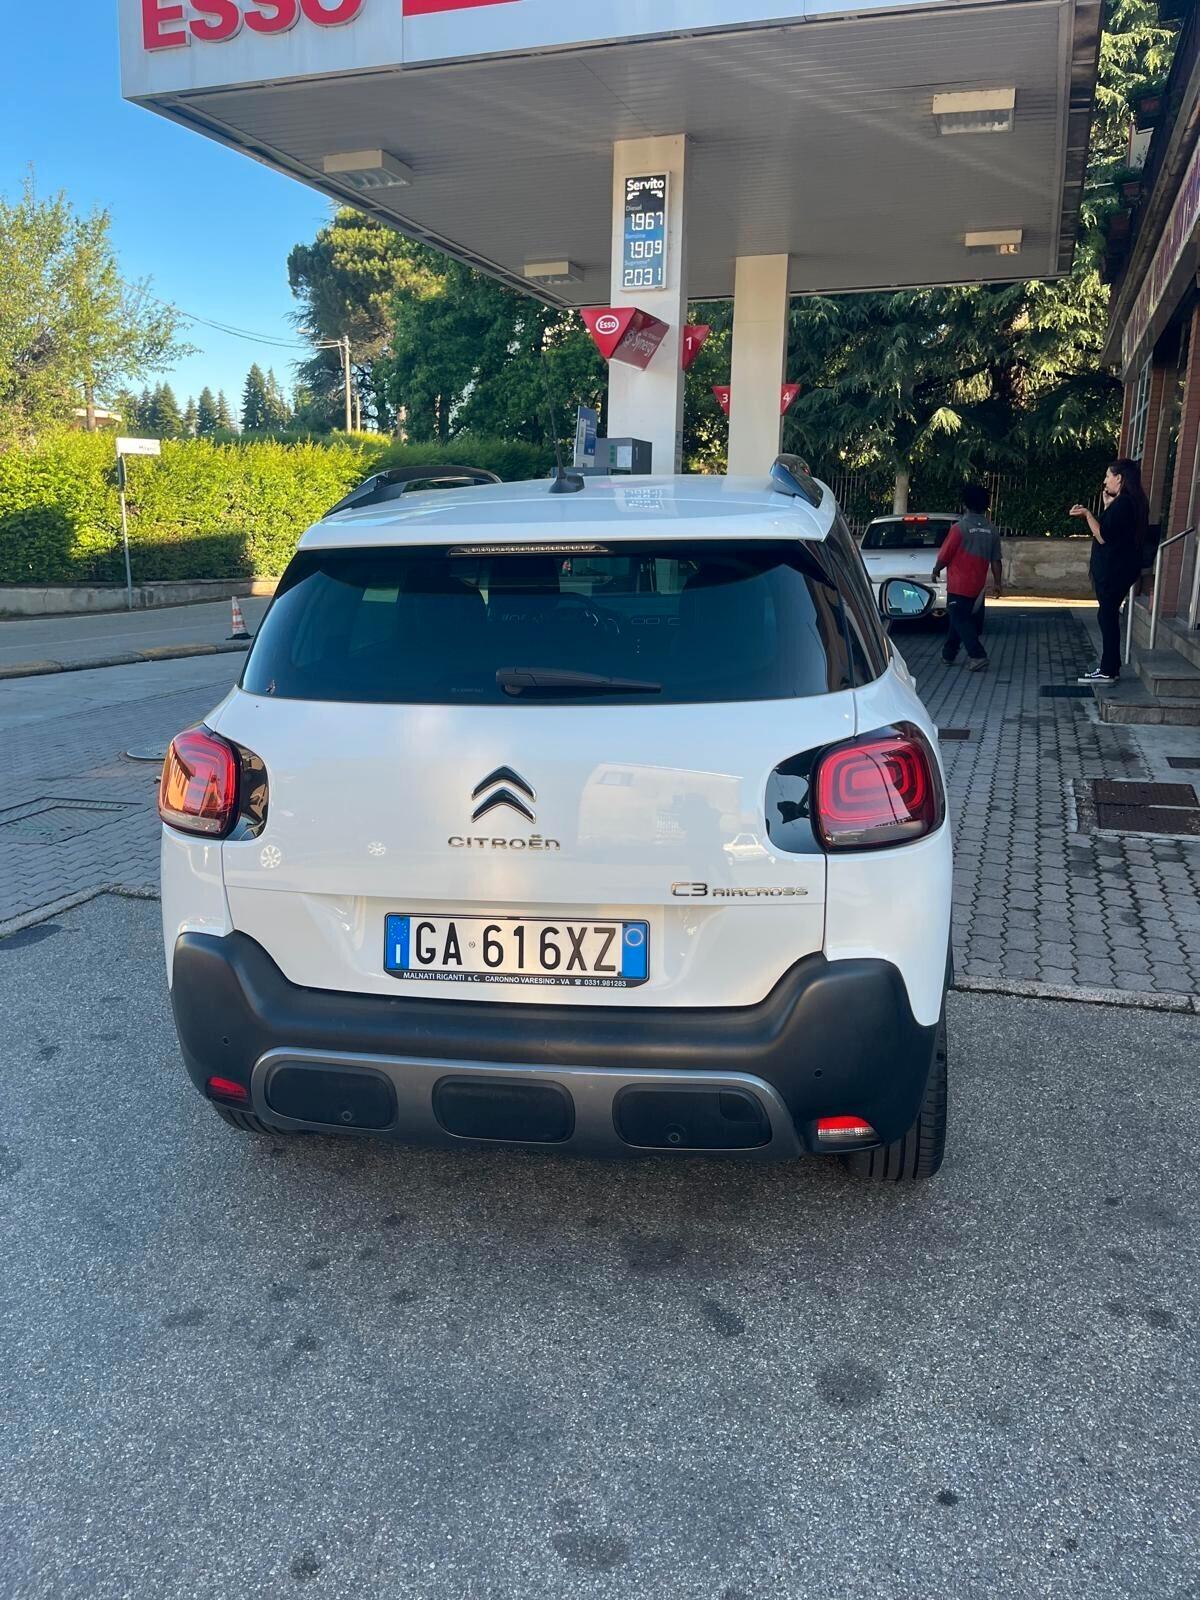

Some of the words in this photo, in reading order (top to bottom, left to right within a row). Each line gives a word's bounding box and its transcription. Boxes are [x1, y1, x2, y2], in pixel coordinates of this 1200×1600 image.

[626, 177, 664, 191] Servito
[599, 320, 616, 329] Esso
[686, 336, 693, 350] 1
[722, 393, 729, 403] 3
[782, 391, 791, 402] 4
[447, 834, 561, 850] CITROËN
[671, 881, 708, 897] C3
[712, 887, 809, 897] AIRCROSS
[415, 921, 463, 966] GA
[482, 924, 617, 972] 616XZ
[403, 972, 435, 981] MALNATI
[436, 972, 465, 981] RIGANTI
[485, 975, 520, 983] CARONNO
[520, 977, 556, 985] VARESINO
[584, 979, 627, 987] 0331.981283
